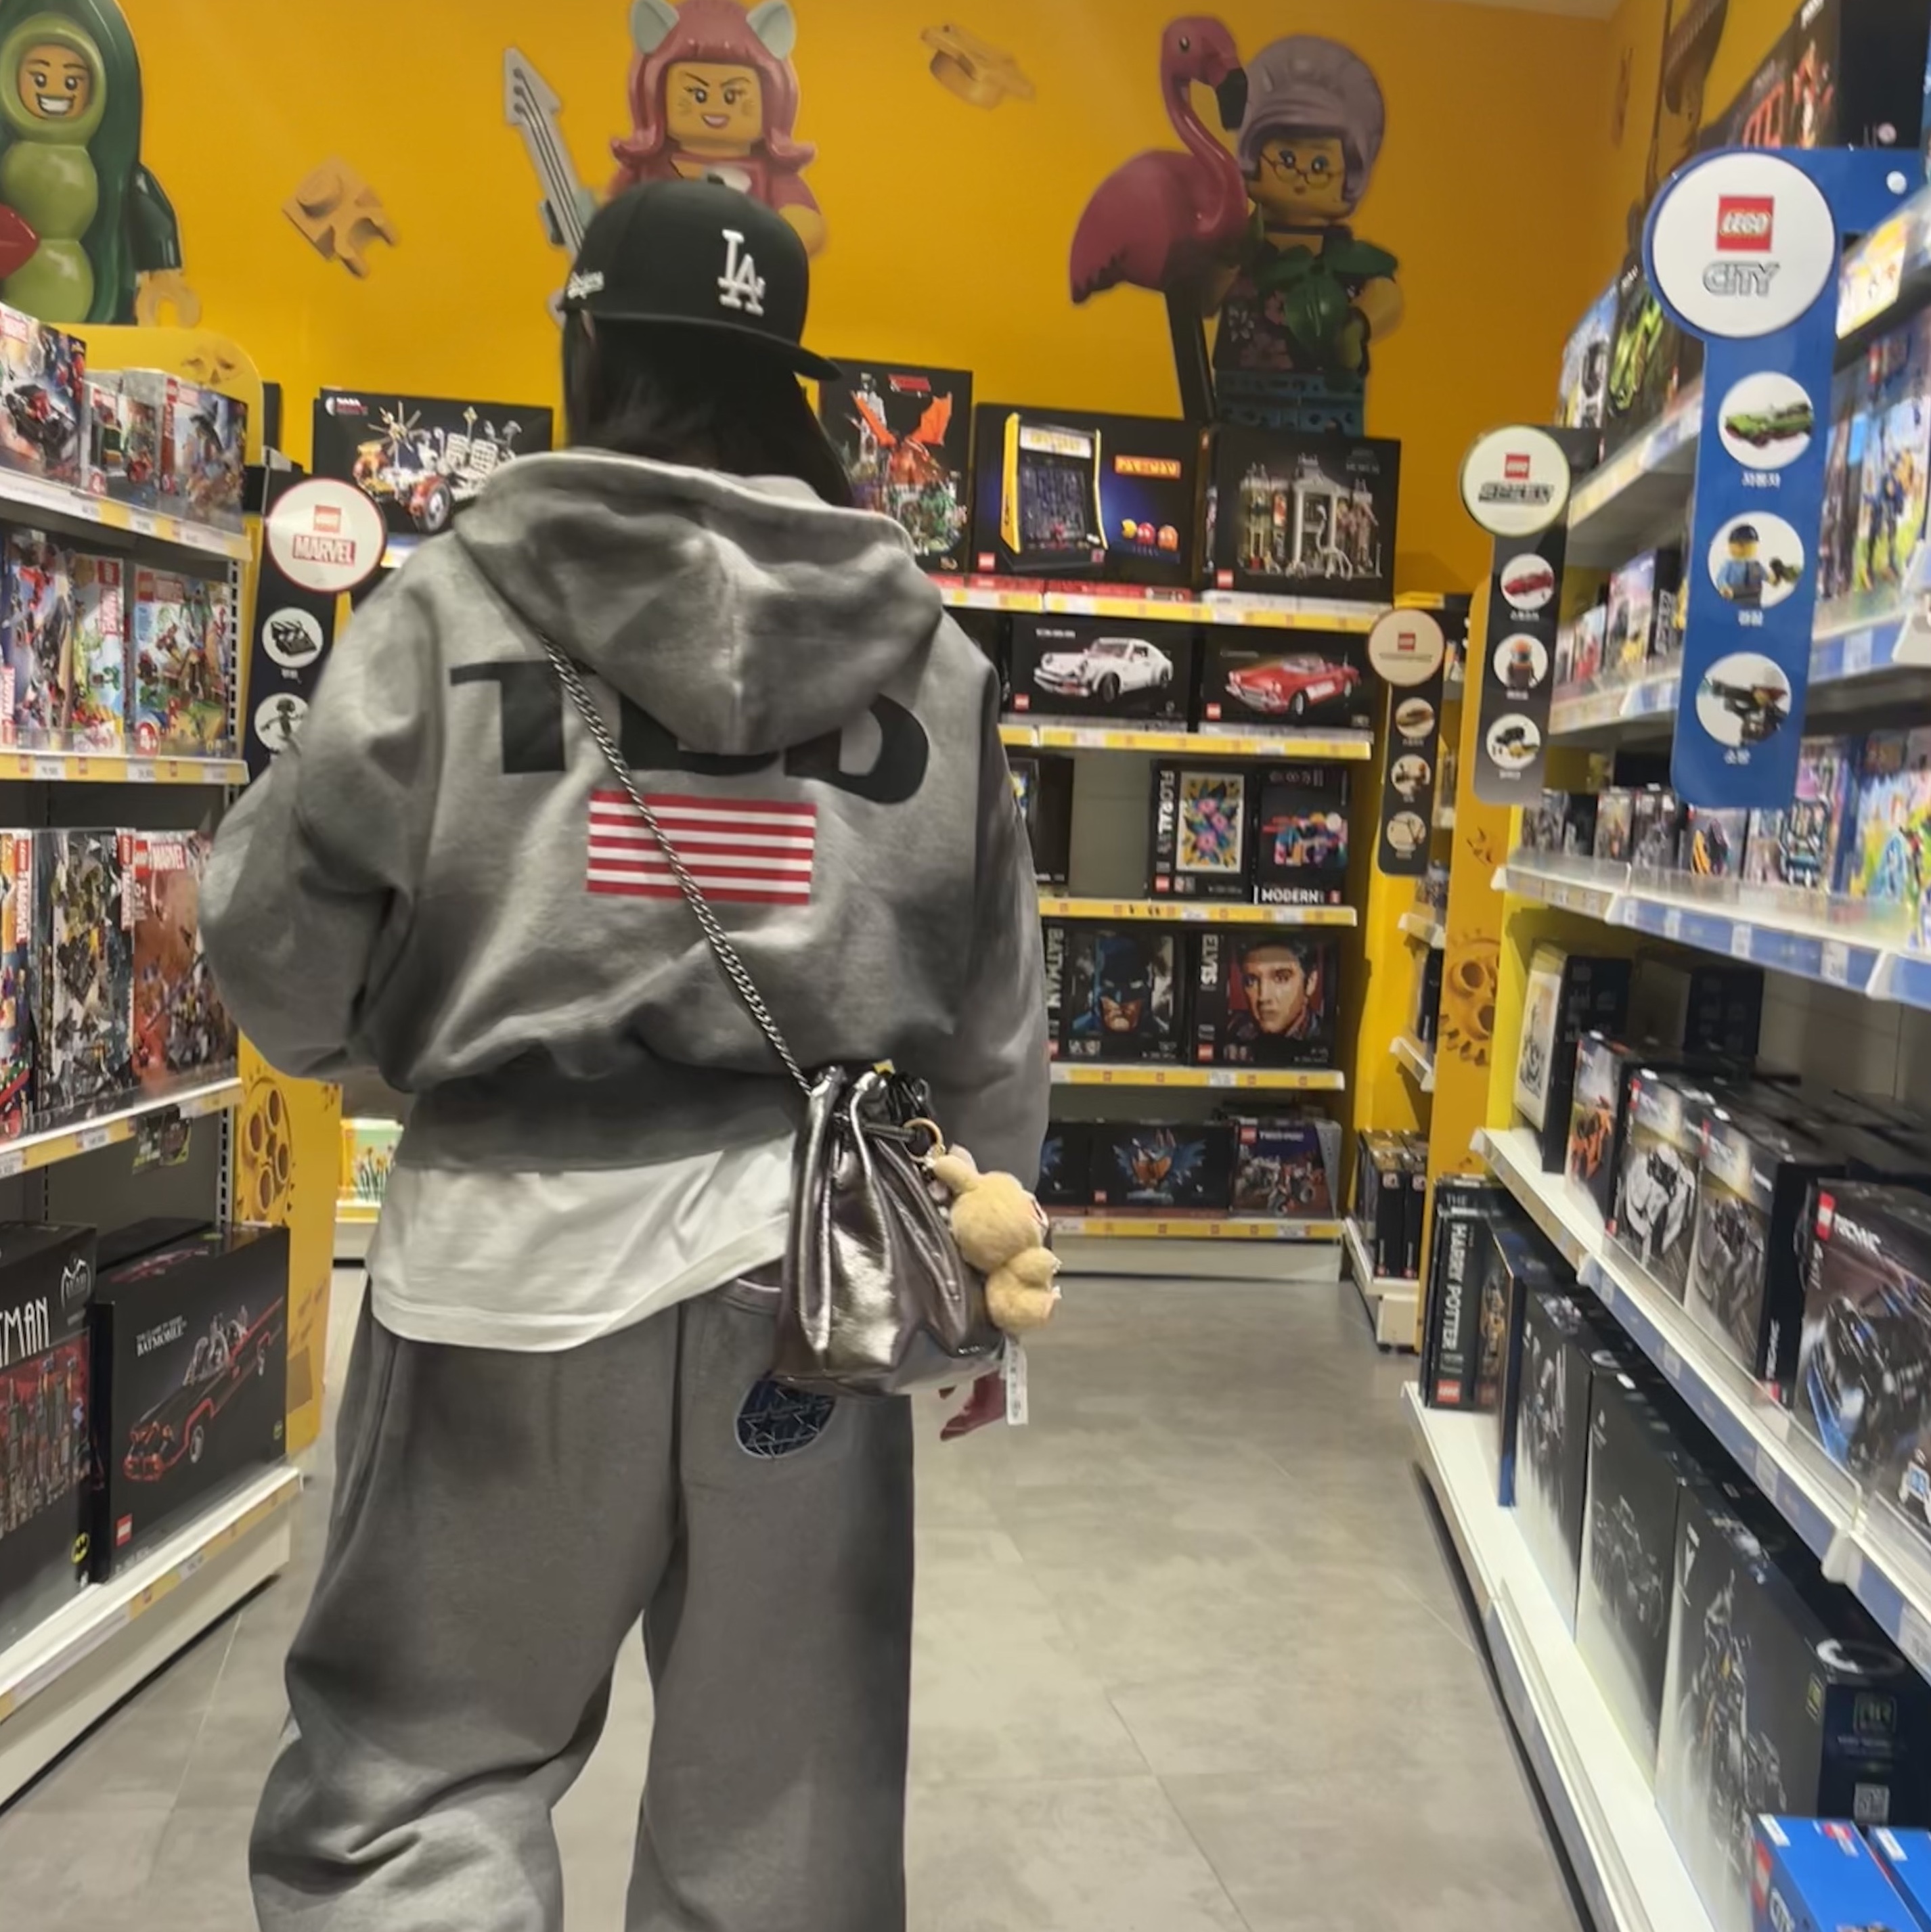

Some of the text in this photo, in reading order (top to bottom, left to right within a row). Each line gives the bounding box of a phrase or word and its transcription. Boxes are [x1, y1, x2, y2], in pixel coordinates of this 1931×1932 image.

[1719, 210, 1769, 235] LEGO
[717, 228, 766, 317] LA
[1702, 260, 1781, 298] CITY
[294, 535, 355, 566] MARVEL
[1158, 770, 1175, 836] FLORAL
[1260, 886, 1318, 903] MODERN
[1046, 928, 1065, 1008] BATMAN
[1199, 933, 1218, 985] ELVIS
[1447, 1222, 1467, 1282] HARRY
[1442, 1284, 1463, 1351] POTTER
